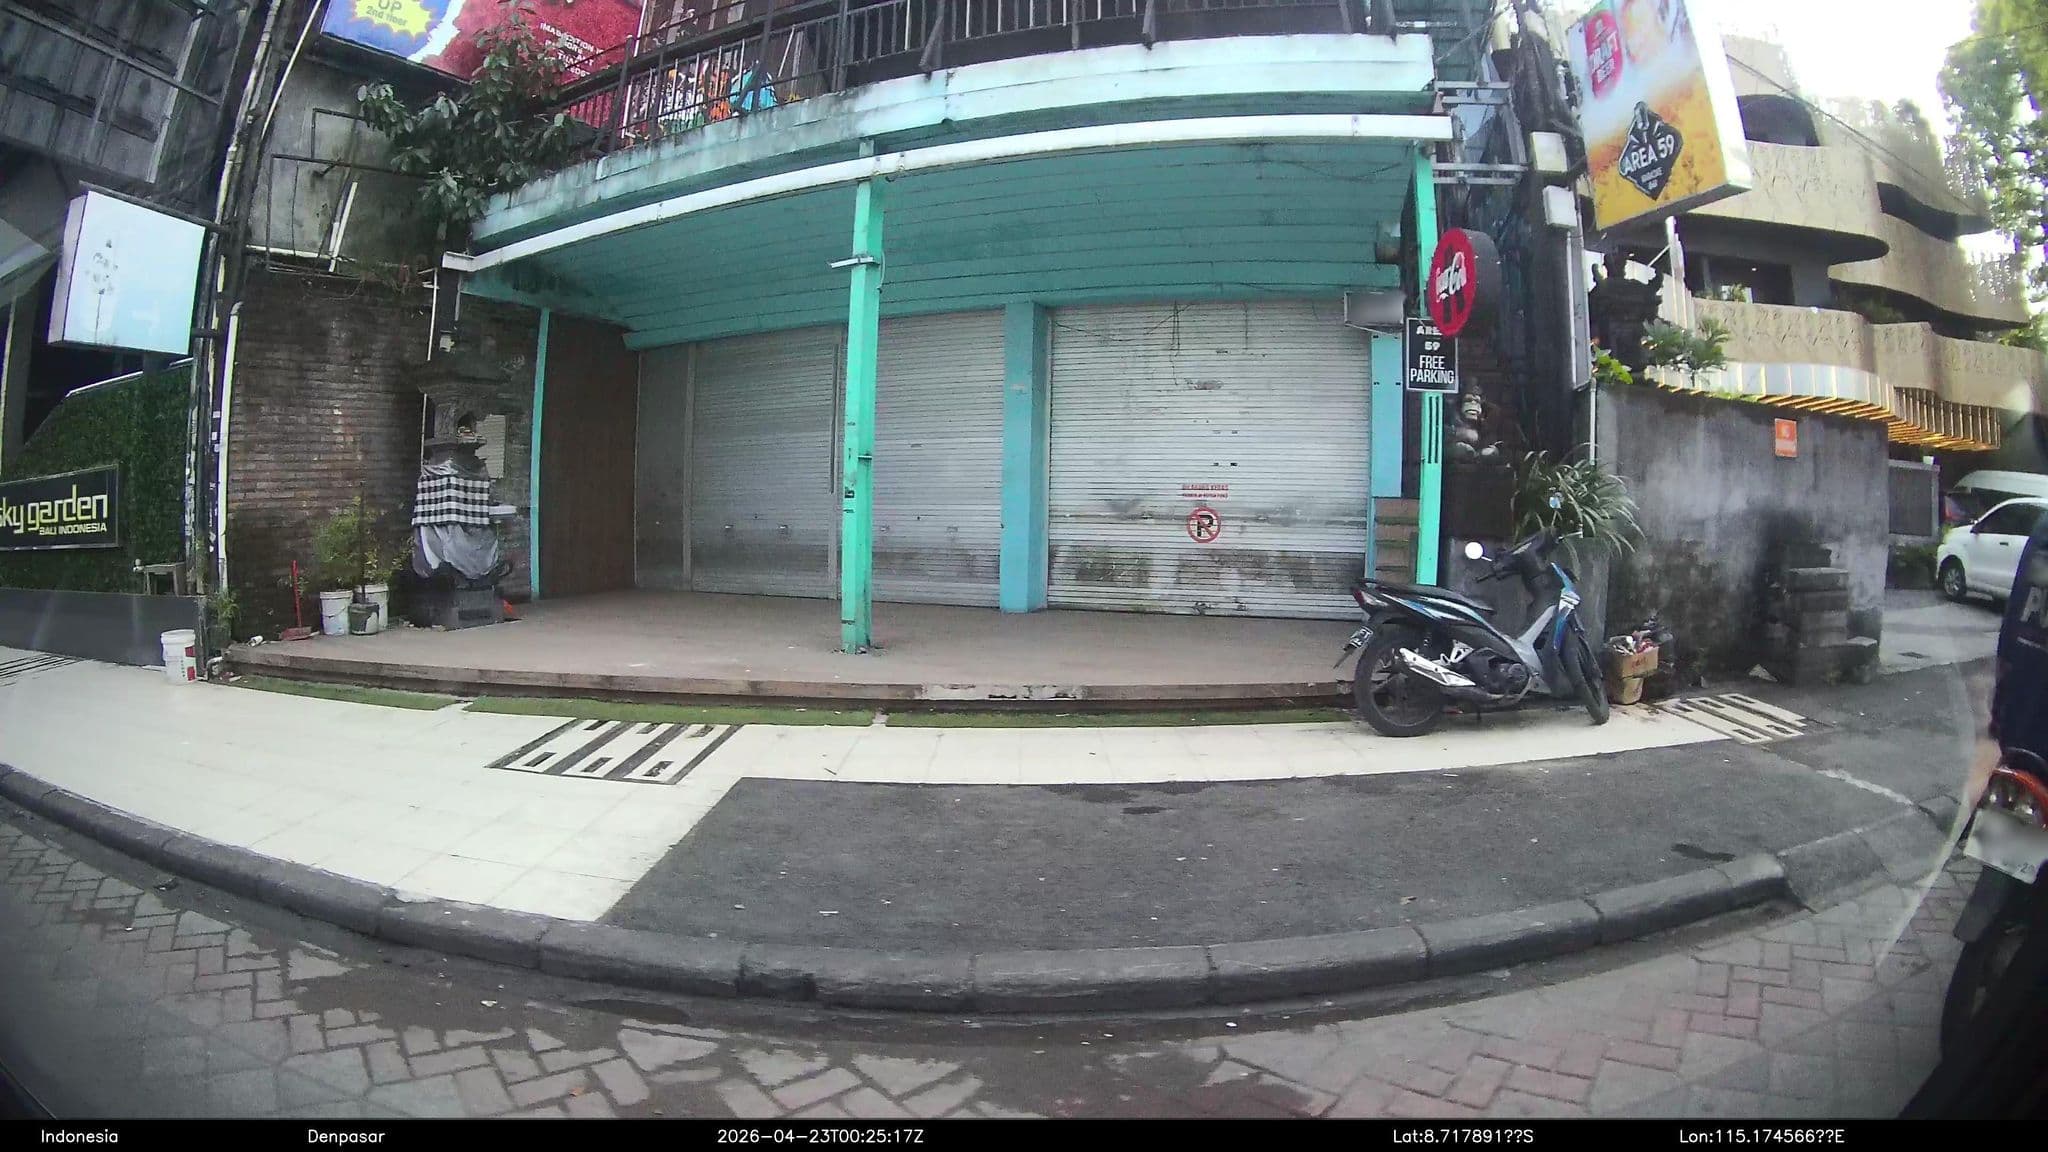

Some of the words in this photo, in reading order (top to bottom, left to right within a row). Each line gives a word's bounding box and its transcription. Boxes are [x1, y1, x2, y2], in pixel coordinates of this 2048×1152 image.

[1624, 144, 1658, 174] AREA
[1658, 134, 1675, 158] 59
[1416, 325, 1442, 336] ARE
[1424, 341, 1440, 351] 59
[1419, 355, 1445, 369] FREE
[1410, 368, 1455, 384] PARKING
[28, 484, 108, 531] garden
[40, 526, 57, 535] BALI
[59, 522, 107, 535] INDONESIA
